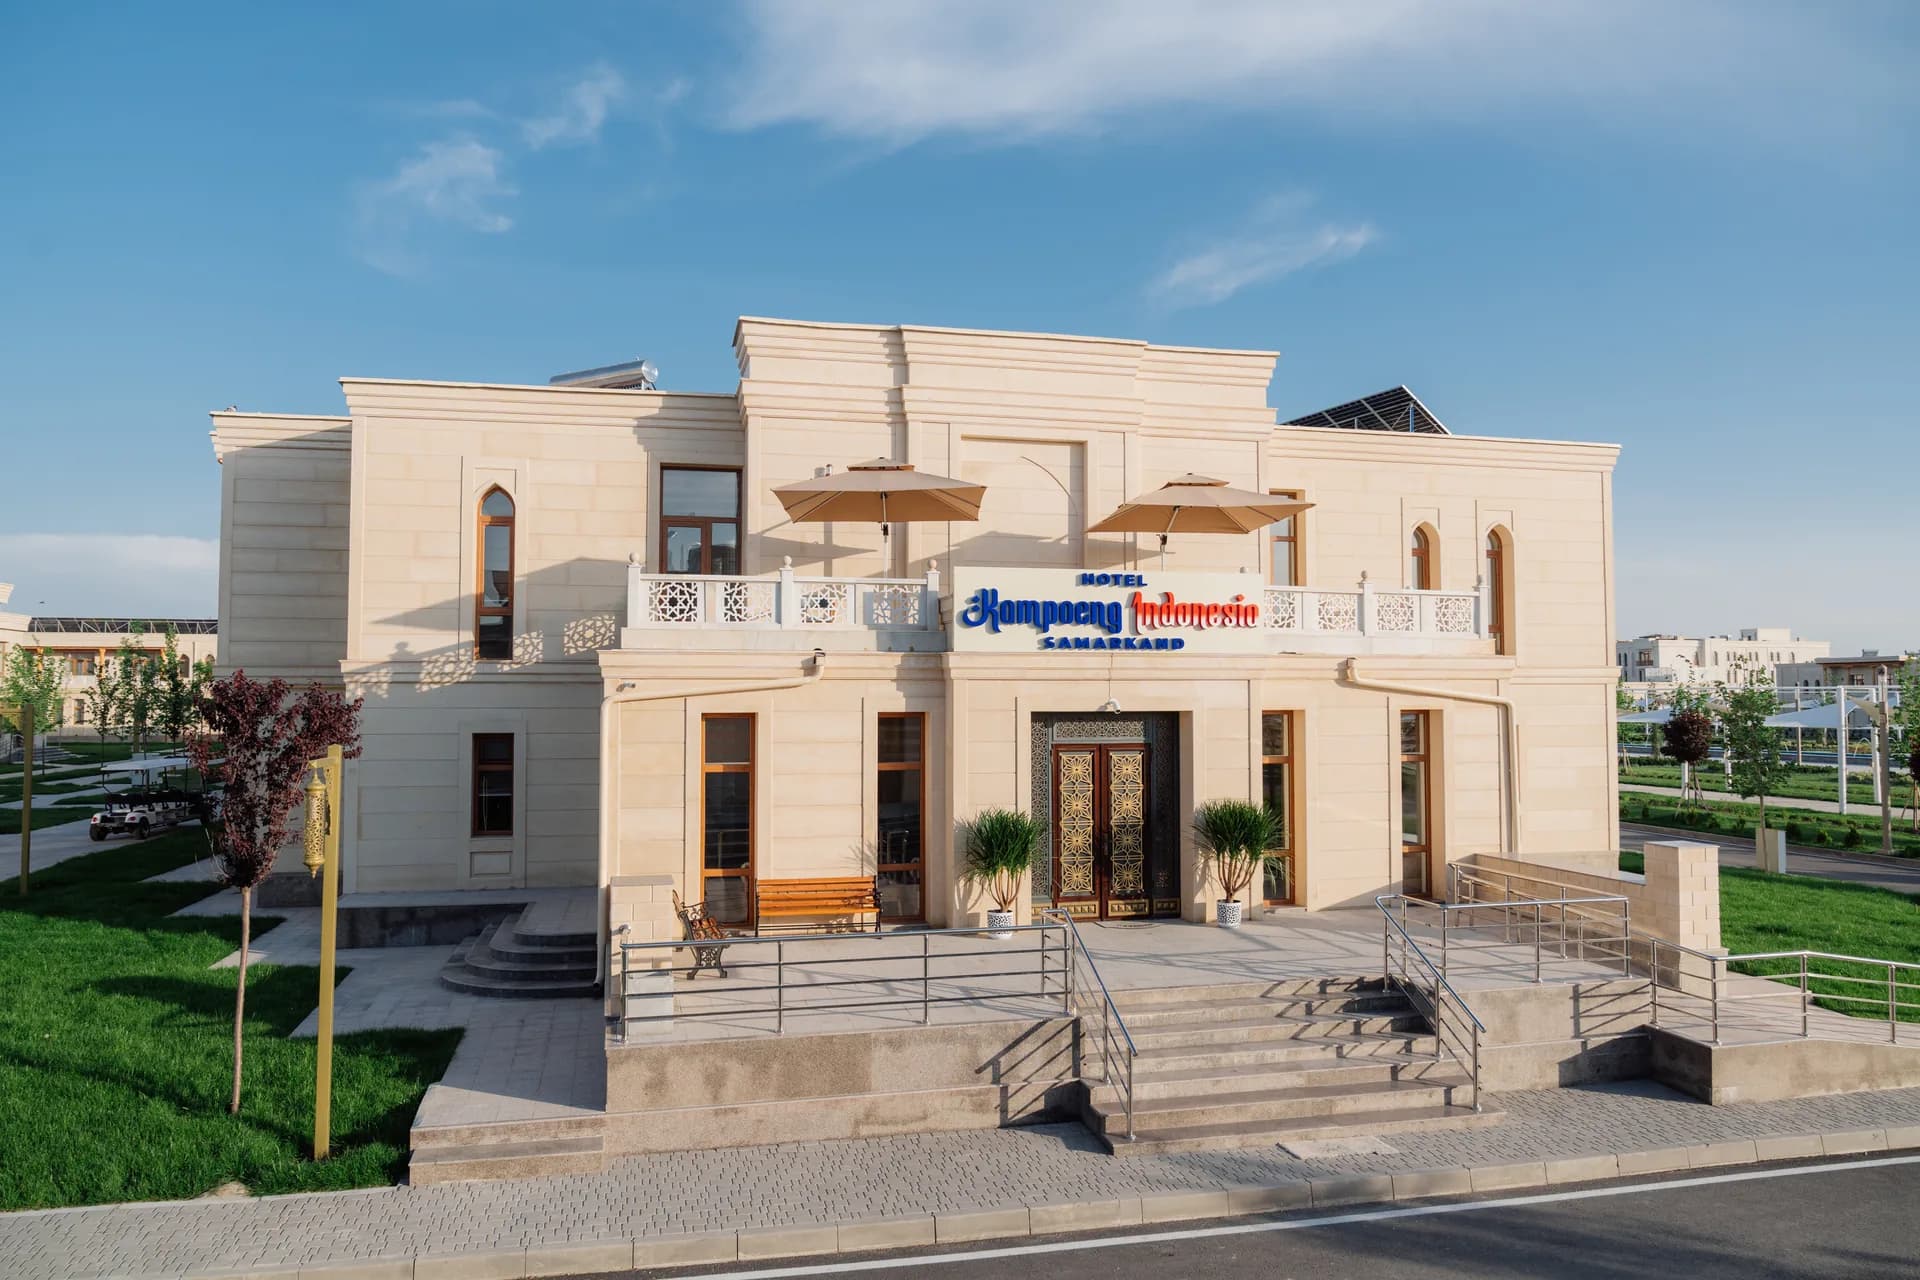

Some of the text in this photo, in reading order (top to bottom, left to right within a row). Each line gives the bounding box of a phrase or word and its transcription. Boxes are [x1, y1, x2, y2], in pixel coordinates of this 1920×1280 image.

[1081, 573, 1148, 587] HOTEL
[962, 588, 1260, 634] Kampoeng Indonesia
[1044, 637, 1185, 650] SAMARKAND
